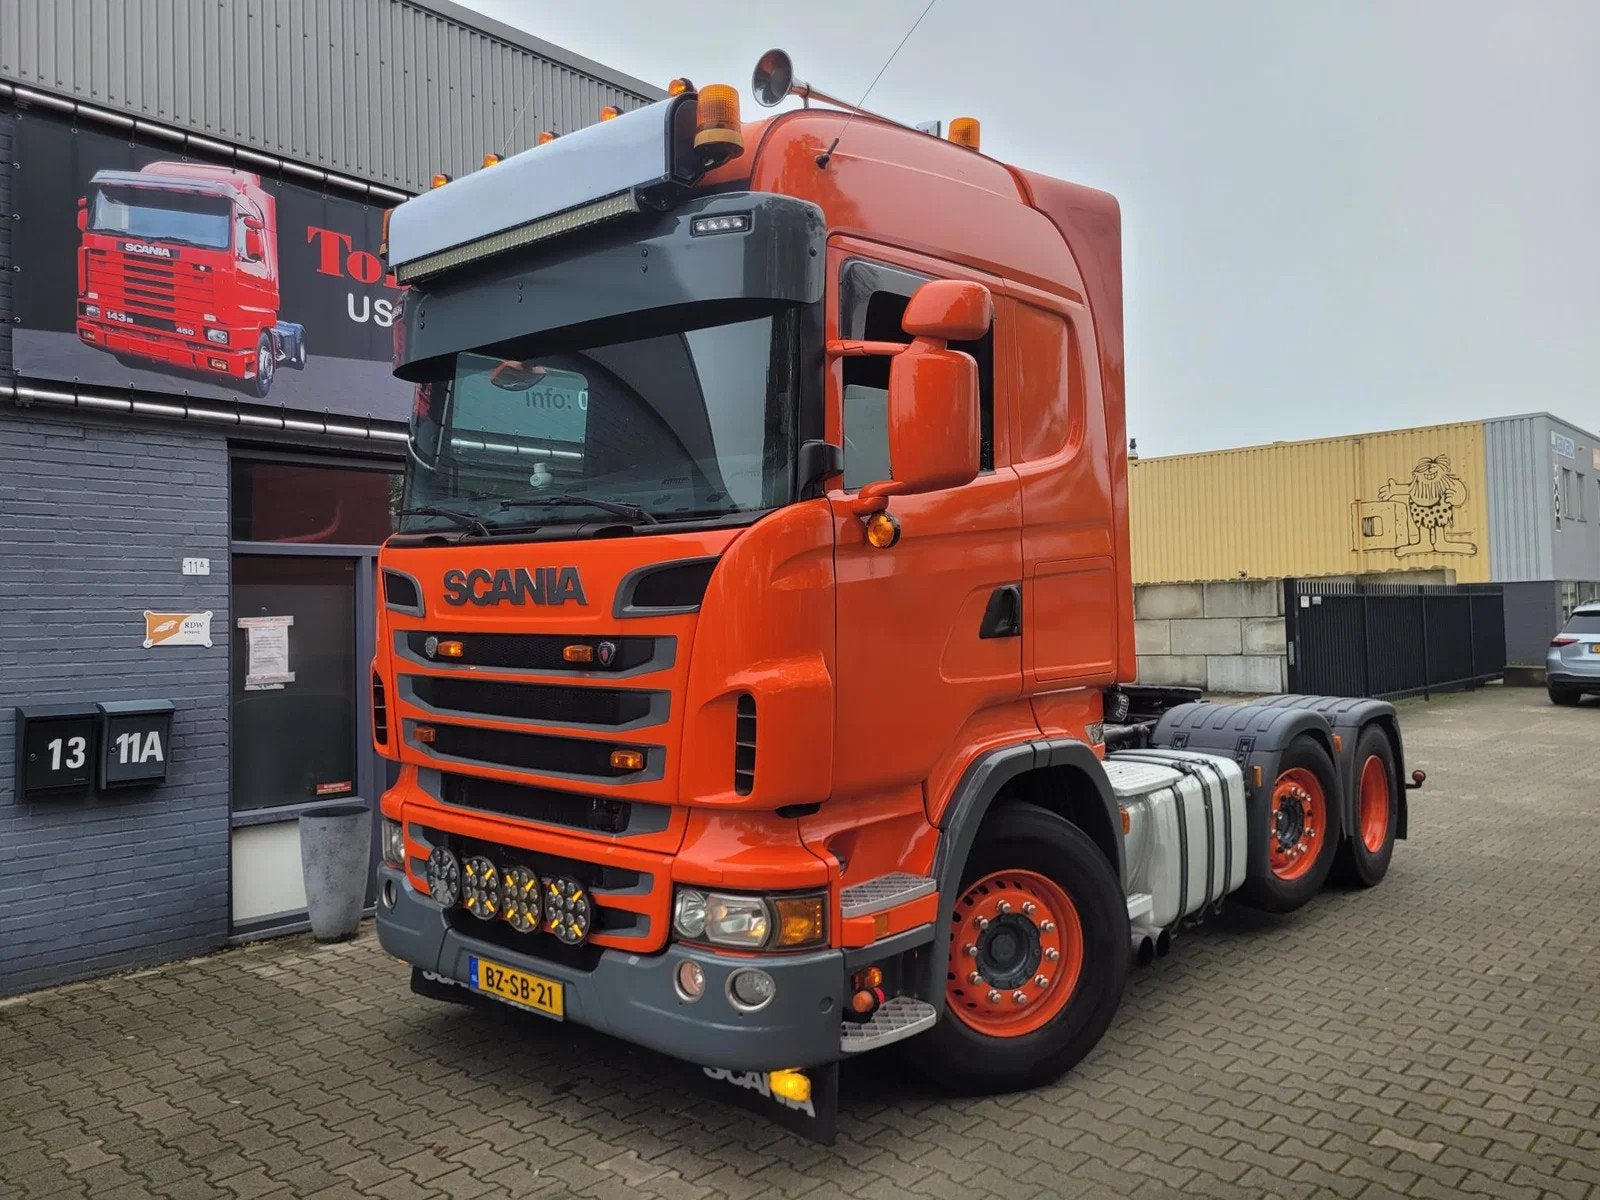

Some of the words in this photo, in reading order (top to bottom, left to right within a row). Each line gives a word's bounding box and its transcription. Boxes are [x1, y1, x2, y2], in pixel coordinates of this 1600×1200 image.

[125, 243, 171, 257] SCANIA
[176, 327, 195, 336] 450
[443, 566, 589, 607] SCANIA
[48, 736, 86, 771] 13
[116, 731, 164, 764] 11A
[485, 966, 553, 1009] BZ-SB-21
